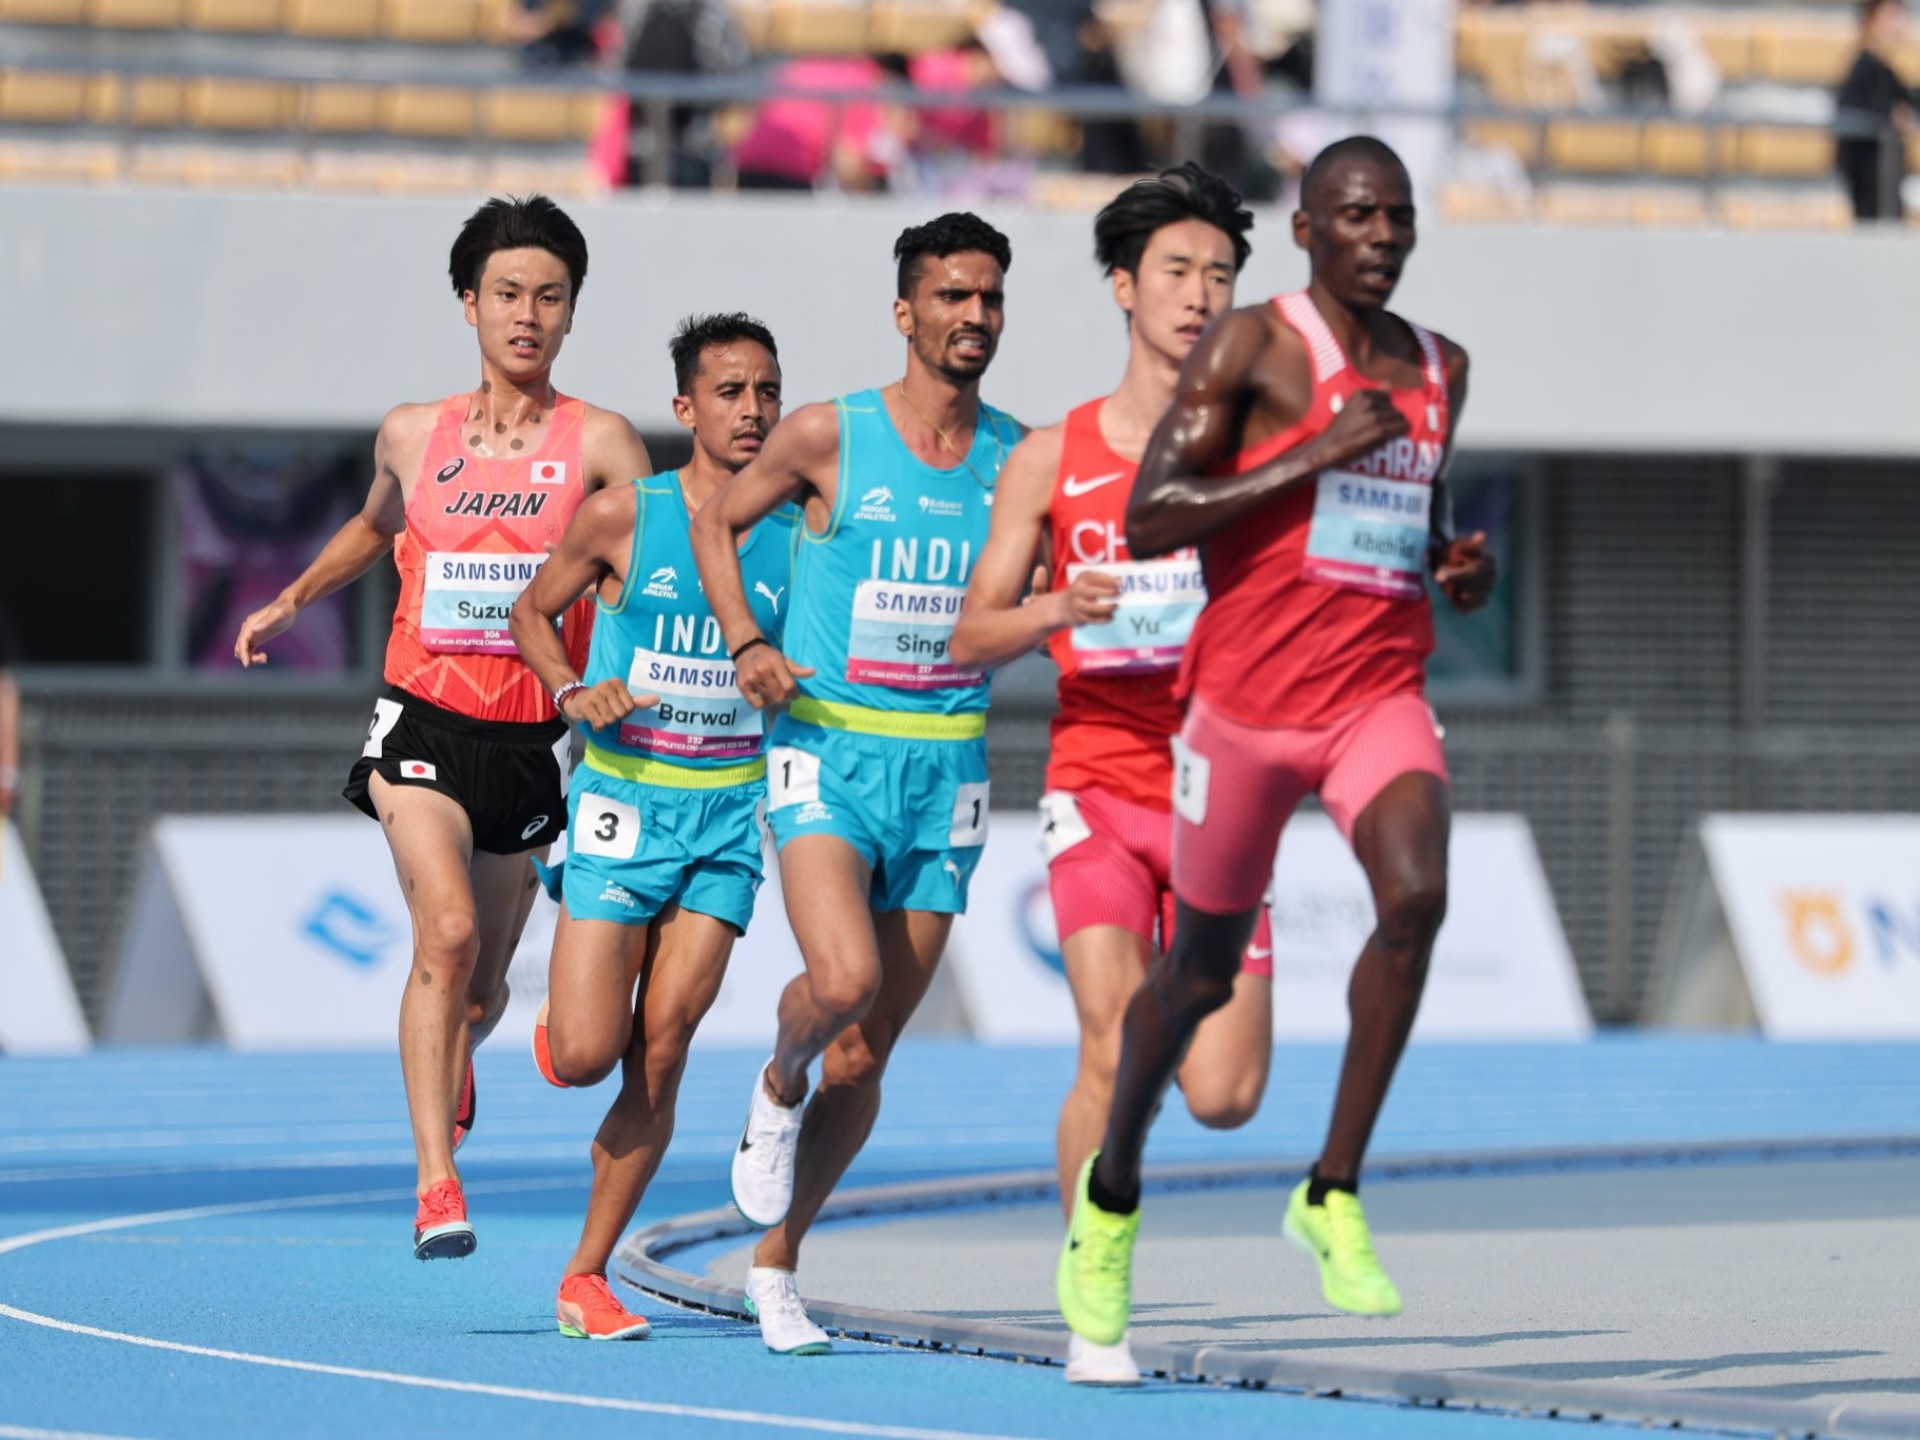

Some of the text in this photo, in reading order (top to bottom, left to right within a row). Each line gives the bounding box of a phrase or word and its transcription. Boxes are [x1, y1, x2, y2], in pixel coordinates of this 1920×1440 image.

[445, 491, 547, 518] JAPAN
[929, 499, 962, 509] Reliance
[1338, 484, 1422, 514] SAMSU
[853, 512, 896, 522] ATHLETICS
[860, 505, 890, 513] INDIAN
[1071, 519, 1127, 564] CH
[648, 582, 673, 591] INDIAN
[1117, 571, 1204, 593] MSUNG
[642, 588, 678, 599] ATHLETICS
[875, 591, 966, 614] SAMSU
[457, 600, 515, 619] Suzu
[484, 630, 500, 639] 306
[653, 613, 732, 656] IND
[1130, 616, 1160, 635] Yu
[485, 639, 515, 647] CHAMPION
[896, 633, 950, 658] Sing
[917, 665, 933, 674] 217
[658, 702, 737, 726] Barwal
[655, 739, 686, 750] ATHLETICS
[687, 735, 704, 744] 232
[782, 760, 792, 789] 1
[972, 798, 981, 829] 1
[594, 812, 620, 842] 3
[599, 893, 634, 908] ATHLETICS
[606, 887, 631, 899] INDIAN
